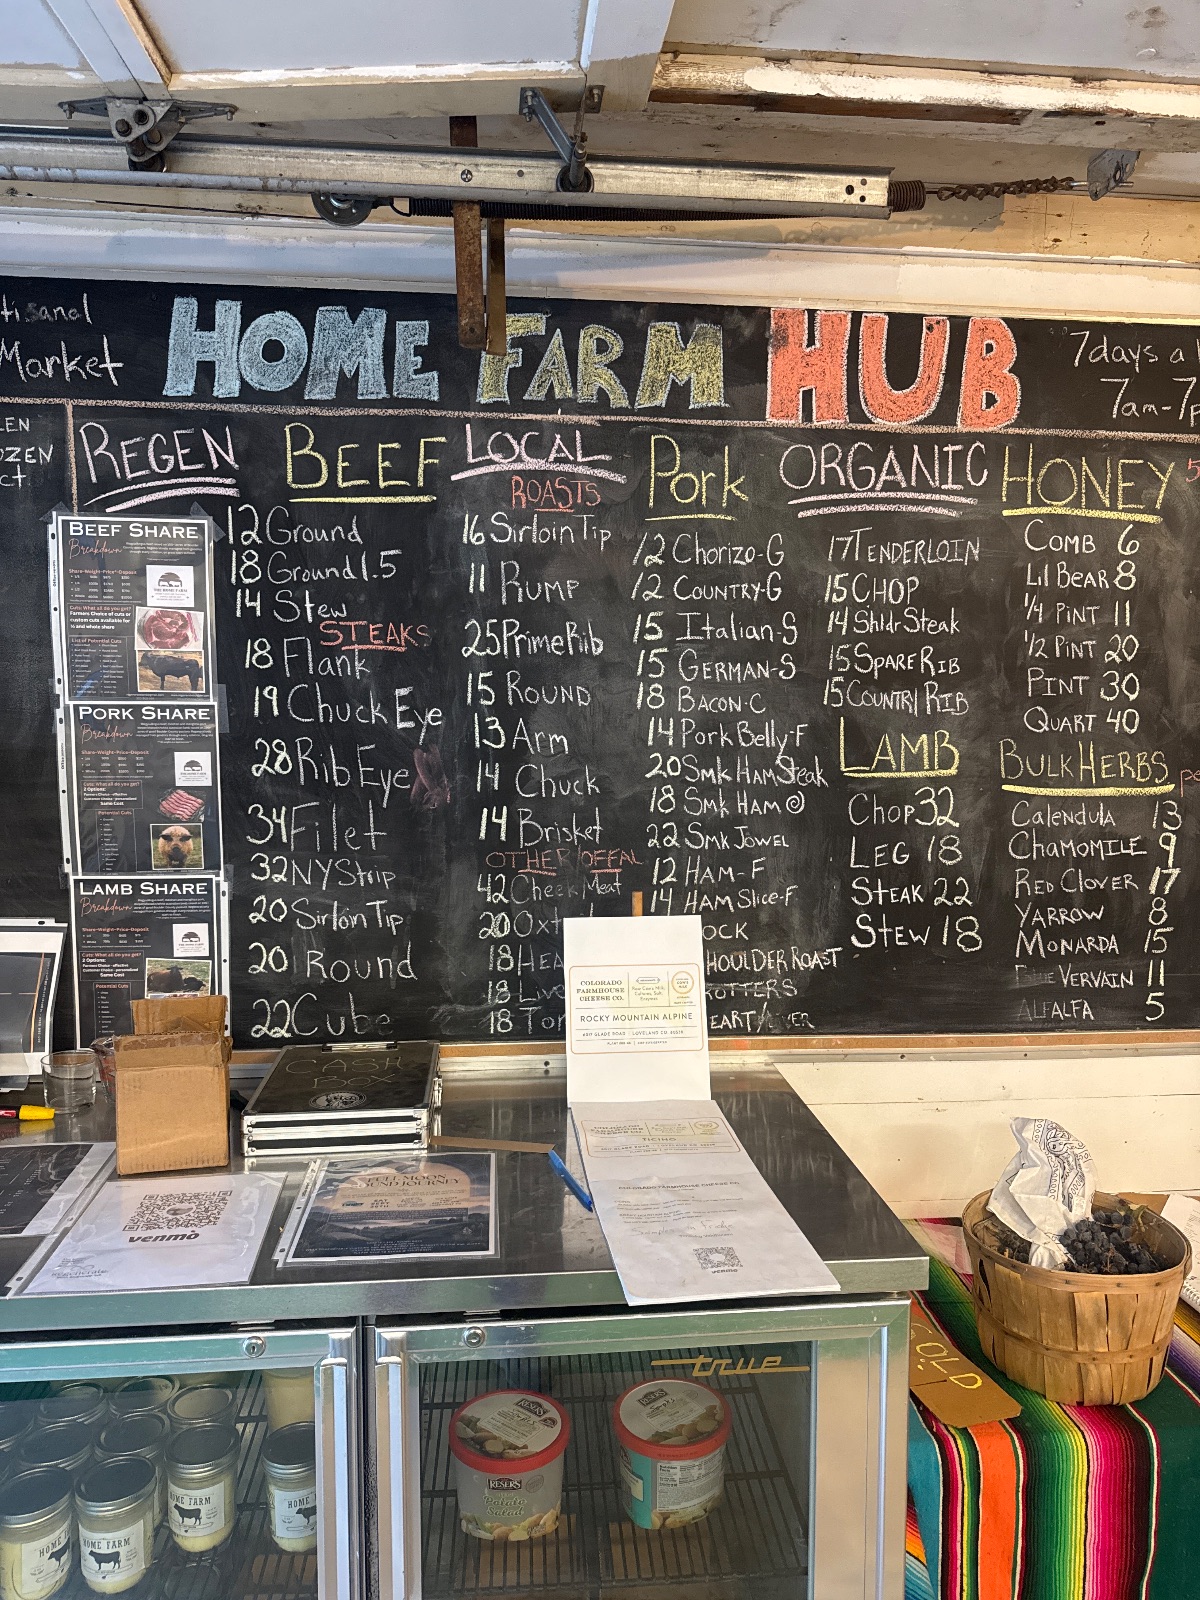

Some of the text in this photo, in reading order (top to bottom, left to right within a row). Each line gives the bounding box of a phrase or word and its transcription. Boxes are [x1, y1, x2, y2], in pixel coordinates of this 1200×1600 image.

[0, 335, 124, 386] Market
[163, 295, 1021, 429] HOME FARM HUB
[1170, 348, 1184, 363] a
[80, 422, 447, 489] REGEN BEEF
[466, 424, 748, 507] LOCAL Pork
[779, 441, 1175, 509] ORGANIC HONEY
[511, 475, 601, 508] ROASTS
[69, 522, 199, 539] BEEF SHARE
[228, 504, 363, 545] 12 Ground
[463, 512, 611, 550] 16 Sirloin Tip
[1024, 519, 1139, 555] COMB 6
[69, 538, 122, 559] Breakdown
[633, 532, 784, 567] 12 Chorizo-G
[828, 527, 980, 565] 17 TENDERLOIN
[231, 550, 262, 585] 18
[267, 551, 357, 584] Ground
[469, 563, 485, 594] 11
[1113, 560, 1136, 590] 8
[631, 572, 664, 601] 12
[824, 573, 919, 605] 15 CHOP
[236, 588, 347, 623] 14 Stew
[827, 606, 960, 635] 14 Steak
[1114, 600, 1130, 627] 11
[319, 620, 432, 647] STEAKS
[462, 619, 603, 658] 25 Prime Rib
[633, 611, 798, 645] 15 Italian-S
[245, 636, 370, 679] 18 Flank
[637, 648, 669, 678] 15
[829, 644, 851, 672] 15
[1105, 634, 1140, 663] 20
[467, 670, 591, 706] 15 ROUND
[636, 682, 665, 710] 18
[823, 676, 844, 707] 15
[1027, 667, 1140, 701] PINT 30
[79, 706, 210, 720] PORK SHARE
[254, 682, 442, 745] 19 Chuck Eye
[1024, 706, 1140, 734] QUART 40
[81, 724, 132, 744] Breakdown
[474, 713, 569, 754] 13 Arm
[648, 717, 674, 747] 14
[680, 718, 733, 748] Pork
[839, 717, 960, 772] LAMB
[251, 737, 410, 808] 28 Rib Eye
[645, 753, 829, 787] 20 Steak
[999, 738, 1169, 784] BULK HERBS
[476, 760, 600, 798] 14 Chuck
[650, 785, 676, 813] 18
[914, 785, 960, 827] 32
[247, 800, 387, 852] 34 Filet
[479, 805, 603, 848] 14 Brisket
[1152, 800, 1182, 830] 13
[647, 822, 681, 848] 22
[1159, 832, 1177, 868] 9
[850, 835, 963, 868] LEG 18
[251, 853, 288, 882] 32
[653, 857, 677, 885] 12
[1149, 866, 1181, 895] 17
[80, 882, 207, 895] LAMB SHARE
[477, 872, 622, 904] 42 Cheek Meat
[651, 888, 672, 916] 14
[933, 877, 973, 906] 22
[80, 897, 132, 917] Breakdown
[249, 895, 288, 924] 20
[291, 898, 367, 931] Sirloin
[366, 900, 403, 935] Tip
[1014, 897, 1168, 928] YARROW 8
[942, 915, 983, 953] 18
[1015, 927, 1174, 958] MONARDA 15
[248, 941, 418, 982] 20 Round
[489, 944, 514, 972] 18
[791, 947, 843, 971] ROAST
[1059, 960, 1164, 988] VERVAIN 11
[488, 980, 511, 1004] 18
[1017, 992, 1165, 1021] ALFALFA 5
[251, 992, 393, 1038] 22 Cube
[489, 1009, 513, 1033] 18
[580, 1012, 693, 1023] ROCKY MOUNTAIN ALPINE
[286, 1057, 403, 1074] CASH
[312, 1074, 396, 1088] BOX
[128, 1230, 200, 1243] venmo
[690, 1355, 782, 1376] true
[288, 1498, 310, 1508] HOME
[39, 1536, 62, 1558] HOME
[106, 1537, 131, 1549] FARM
